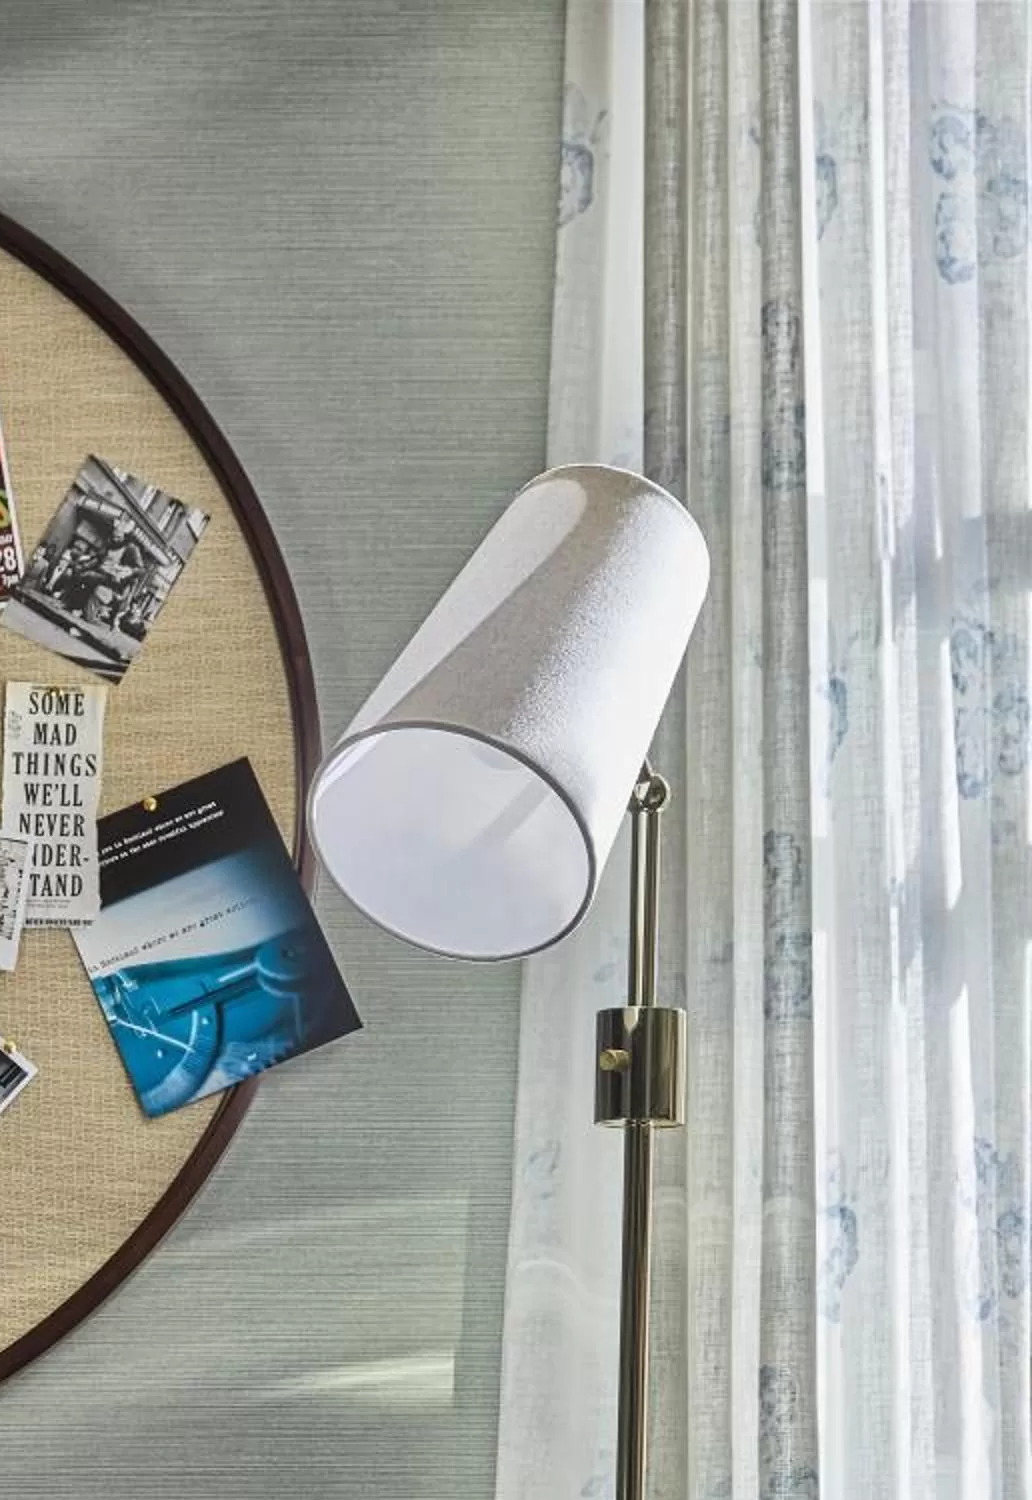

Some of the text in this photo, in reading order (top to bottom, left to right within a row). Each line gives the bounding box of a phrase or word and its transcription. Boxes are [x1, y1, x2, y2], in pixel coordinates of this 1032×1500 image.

[28, 691, 85, 716] SOME
[33, 722, 77, 746] MAD
[12, 751, 97, 777] THINGS
[23, 782, 83, 807] WE'LL
[19, 812, 86, 837] NEVER
[29, 873, 83, 897] TAND
